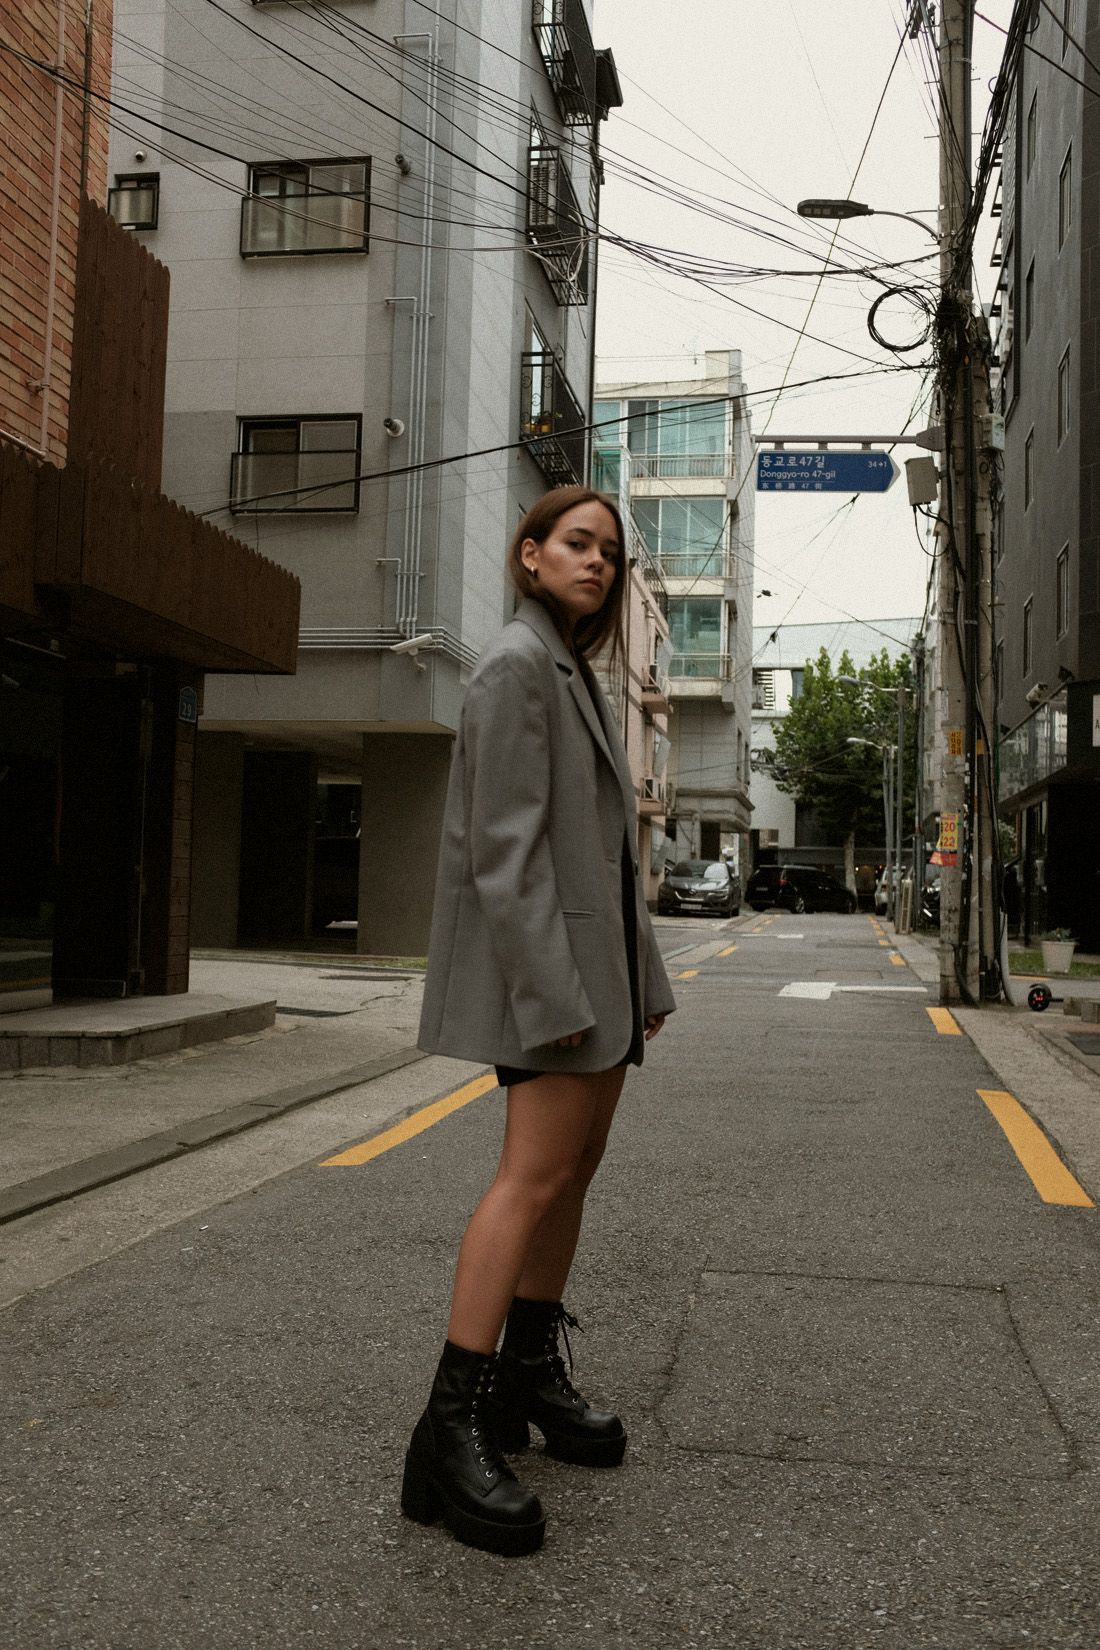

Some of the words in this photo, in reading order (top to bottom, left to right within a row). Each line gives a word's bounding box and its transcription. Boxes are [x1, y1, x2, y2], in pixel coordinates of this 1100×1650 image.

[761, 455, 825, 468] 동교로47길
[760, 470, 810, 479] Donggyo-ro
[811, 470, 836, 479] 47-gil
[944, 822, 956, 832] 20
[944, 836, 955, 847] 22
